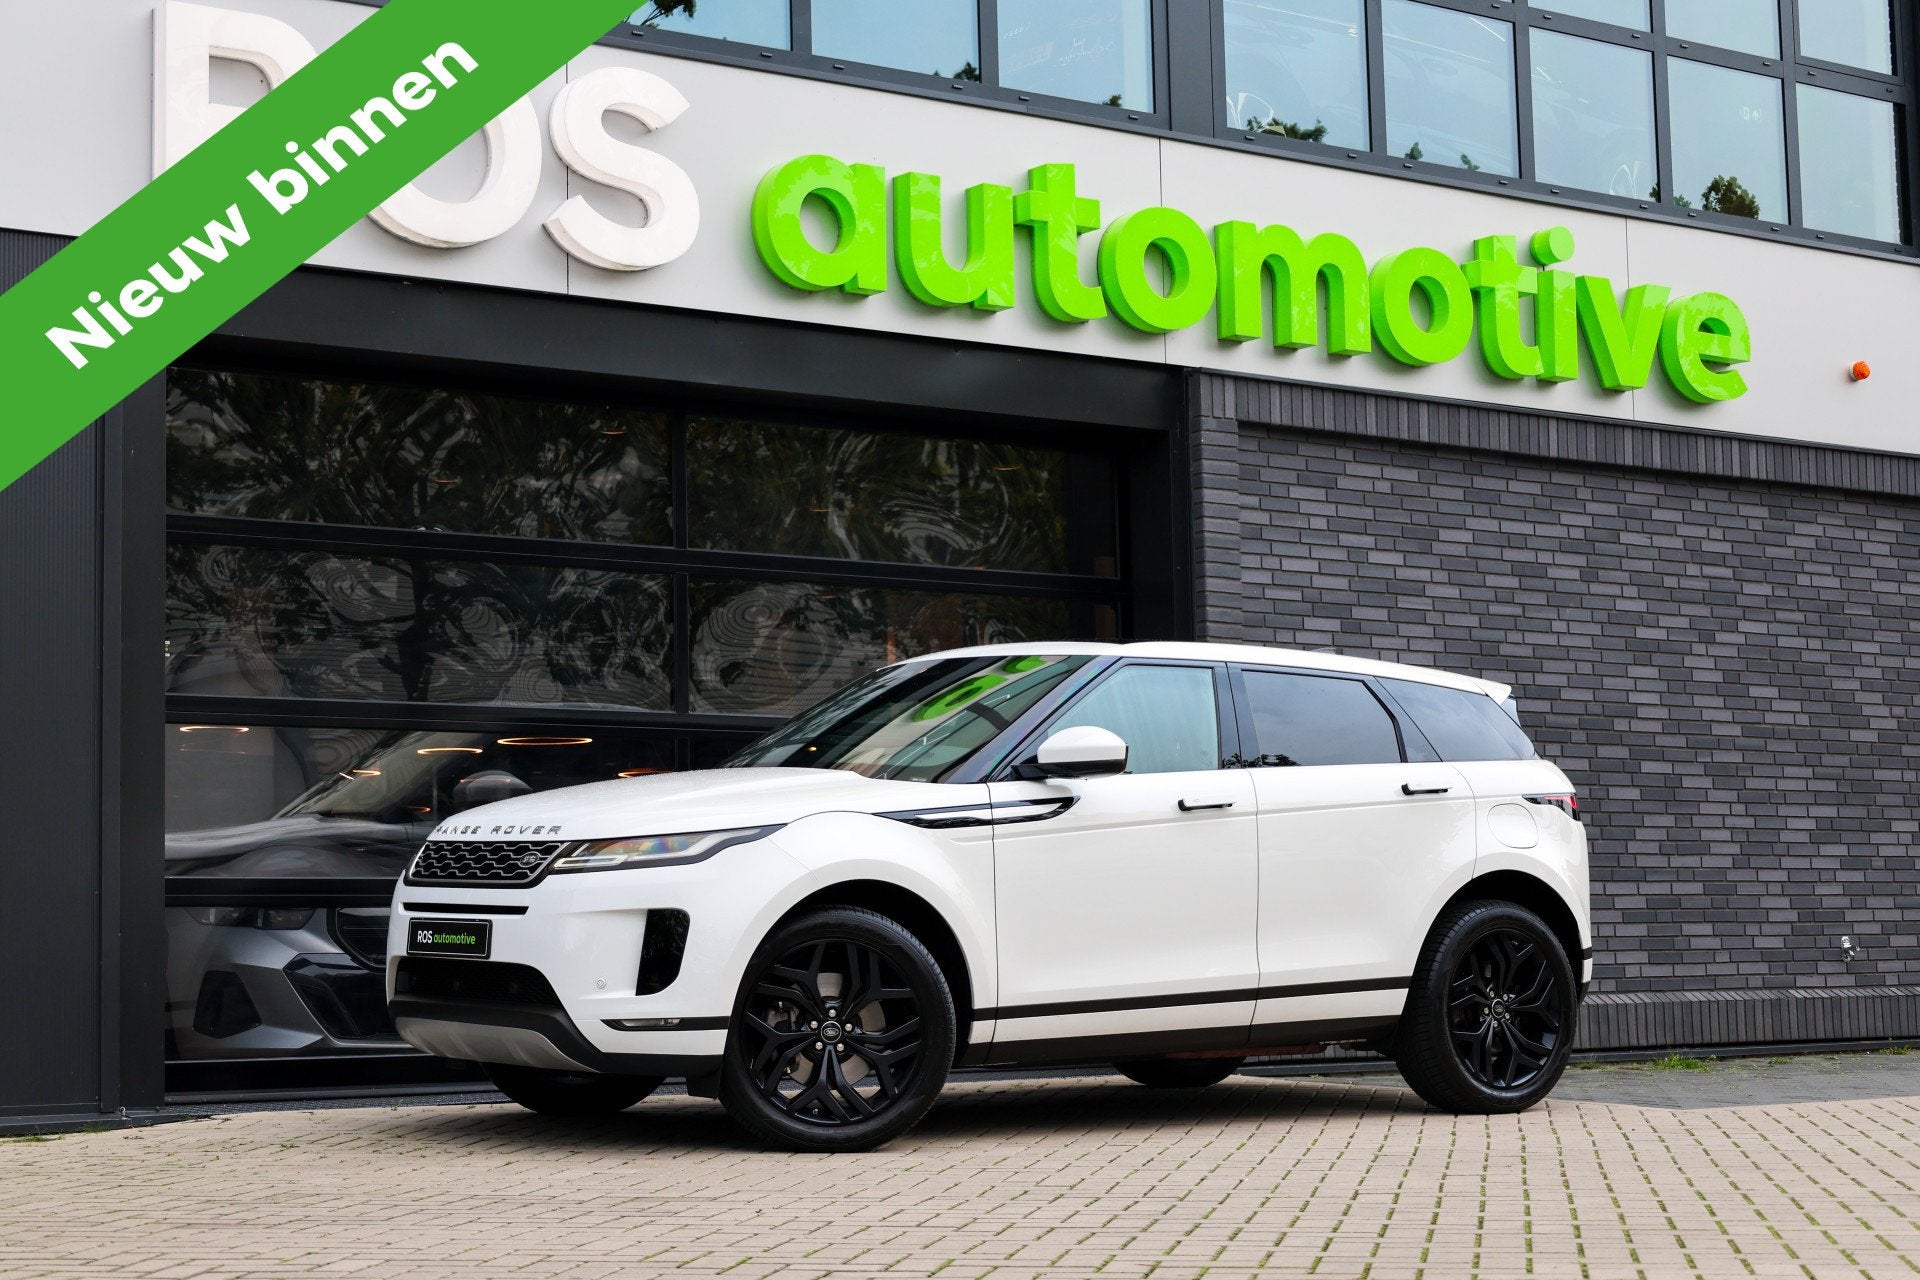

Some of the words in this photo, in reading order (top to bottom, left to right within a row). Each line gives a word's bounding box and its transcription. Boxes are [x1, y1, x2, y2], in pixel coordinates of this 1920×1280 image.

[750, 153, 1751, 402] automotive
[490, 825, 562, 835] ROVER
[417, 930, 433, 944] ROS
[433, 932, 476, 945] automotive
